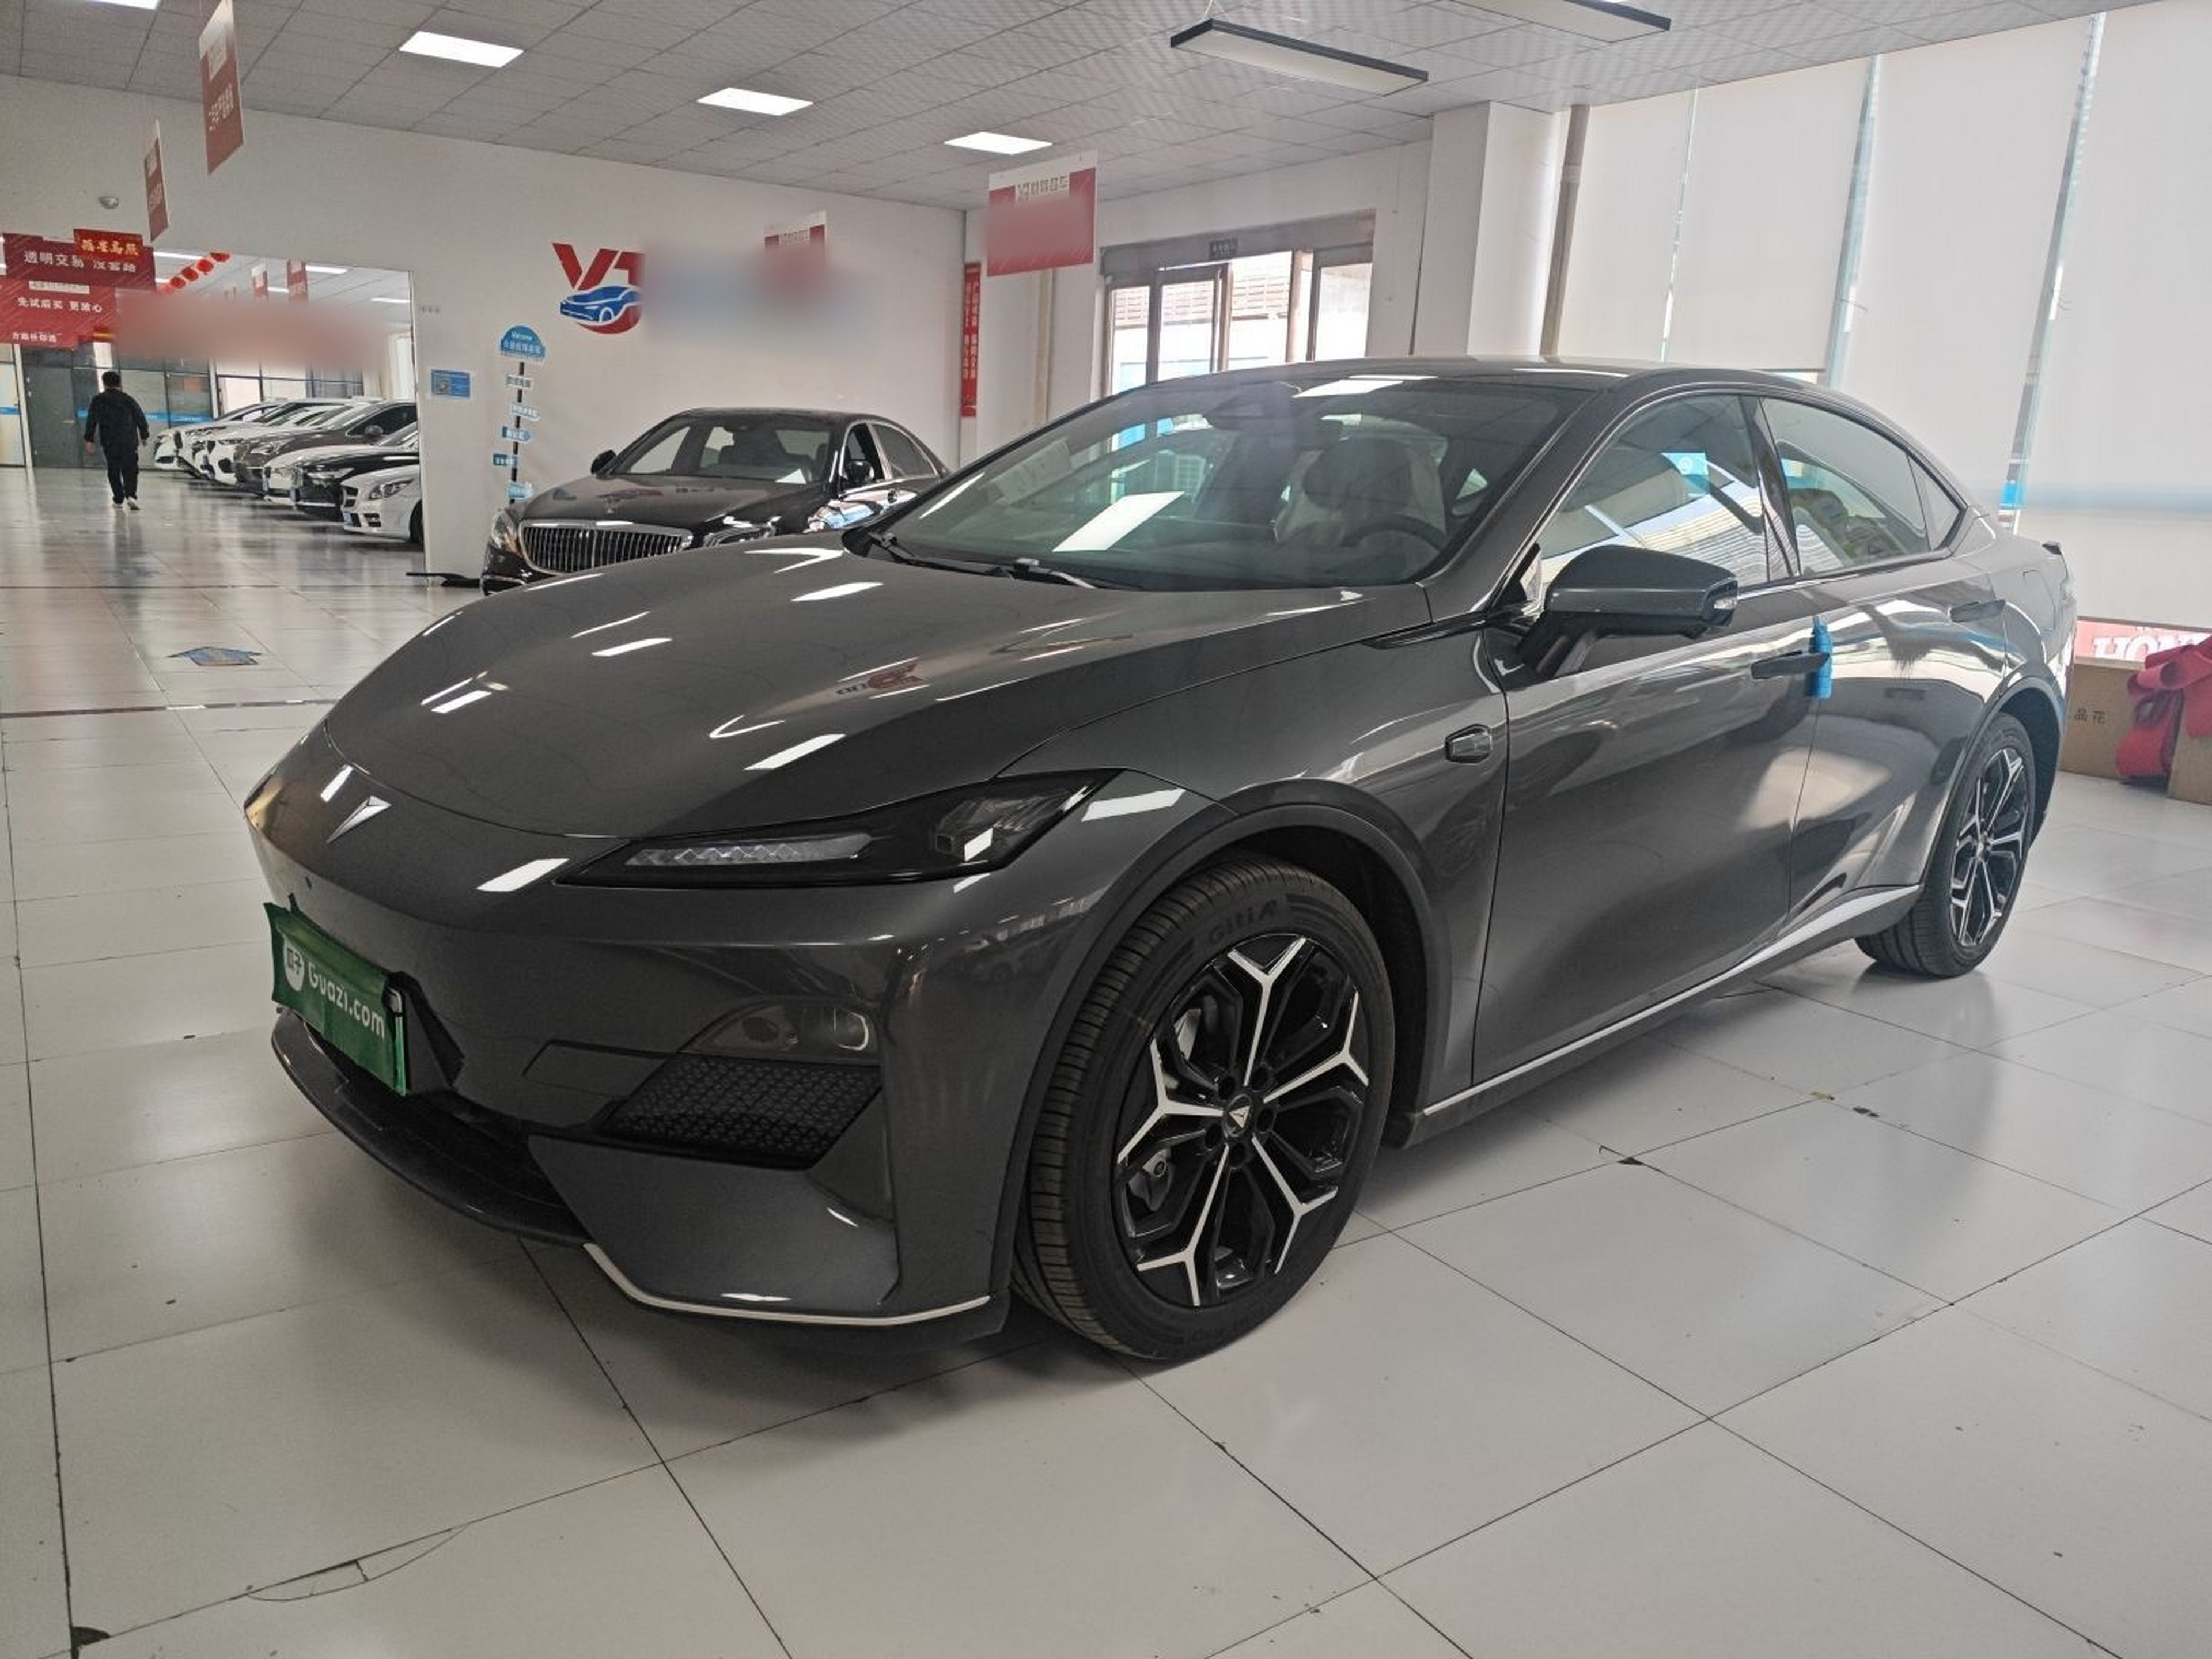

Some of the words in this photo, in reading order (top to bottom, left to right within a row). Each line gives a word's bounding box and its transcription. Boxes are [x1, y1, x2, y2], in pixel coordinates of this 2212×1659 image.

[24, 250, 85, 268] 透明交易
[17, 296, 63, 309] 先试后买
[69, 300, 103, 313] 更放心
